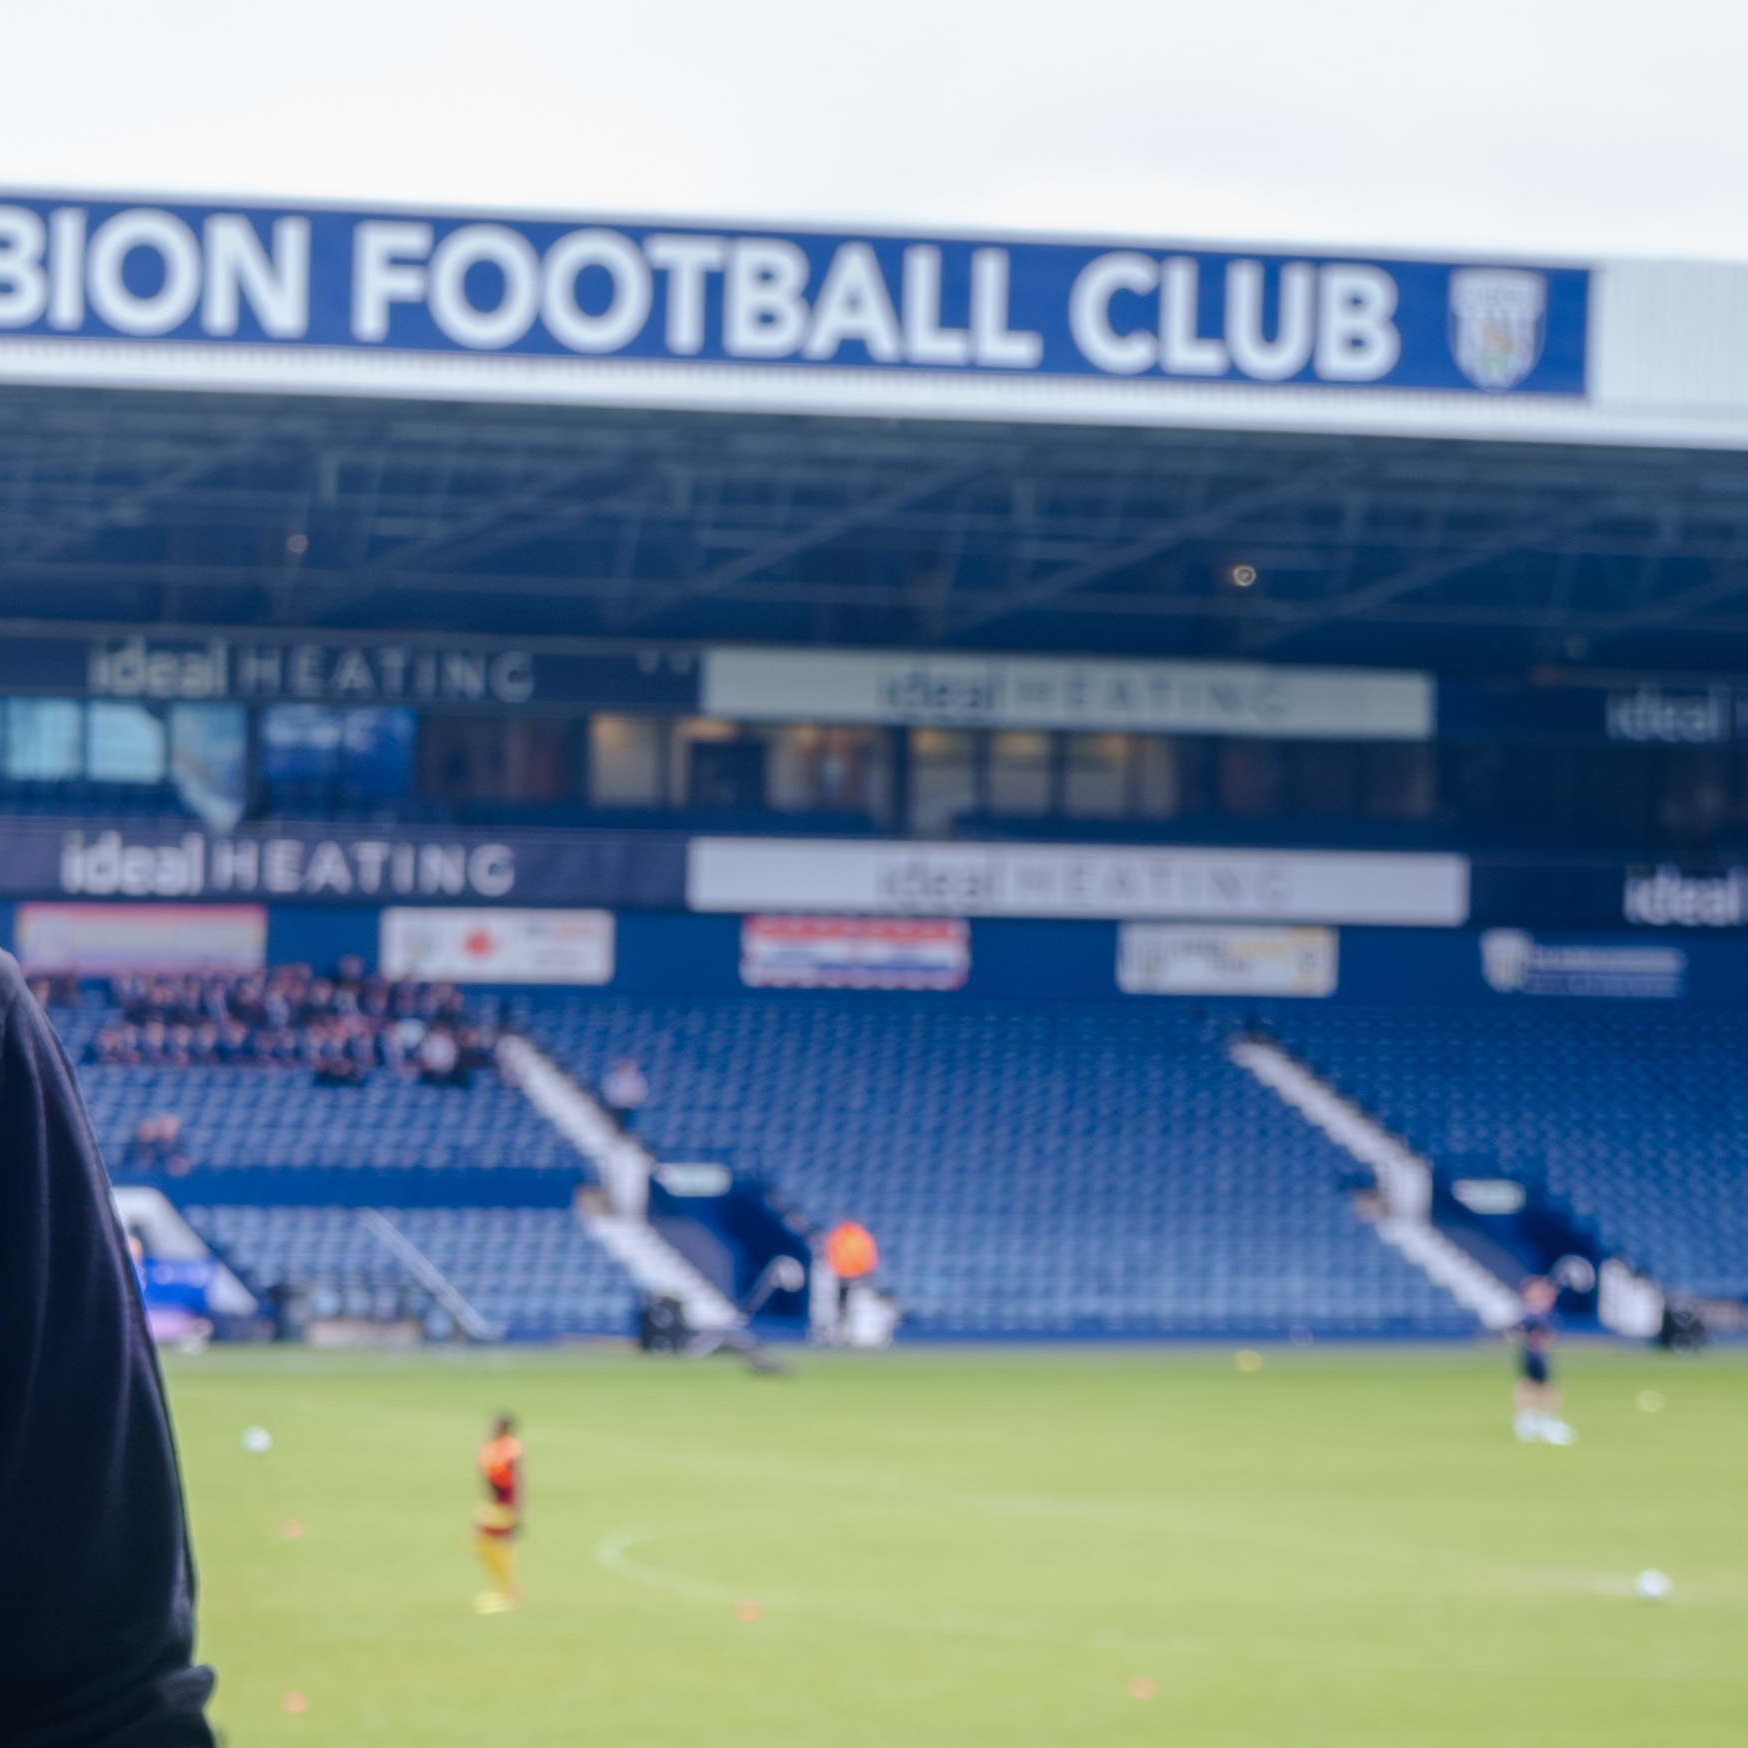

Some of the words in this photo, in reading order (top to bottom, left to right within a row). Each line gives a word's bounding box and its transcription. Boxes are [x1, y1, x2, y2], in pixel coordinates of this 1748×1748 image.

[350, 219, 1046, 373] FOOTBALL
[1067, 248, 1402, 384] CLUB
[89, 639, 228, 698] ideal
[237, 645, 535, 702] HEATING
[59, 830, 205, 896] ideal
[212, 838, 516, 898] HEATING
